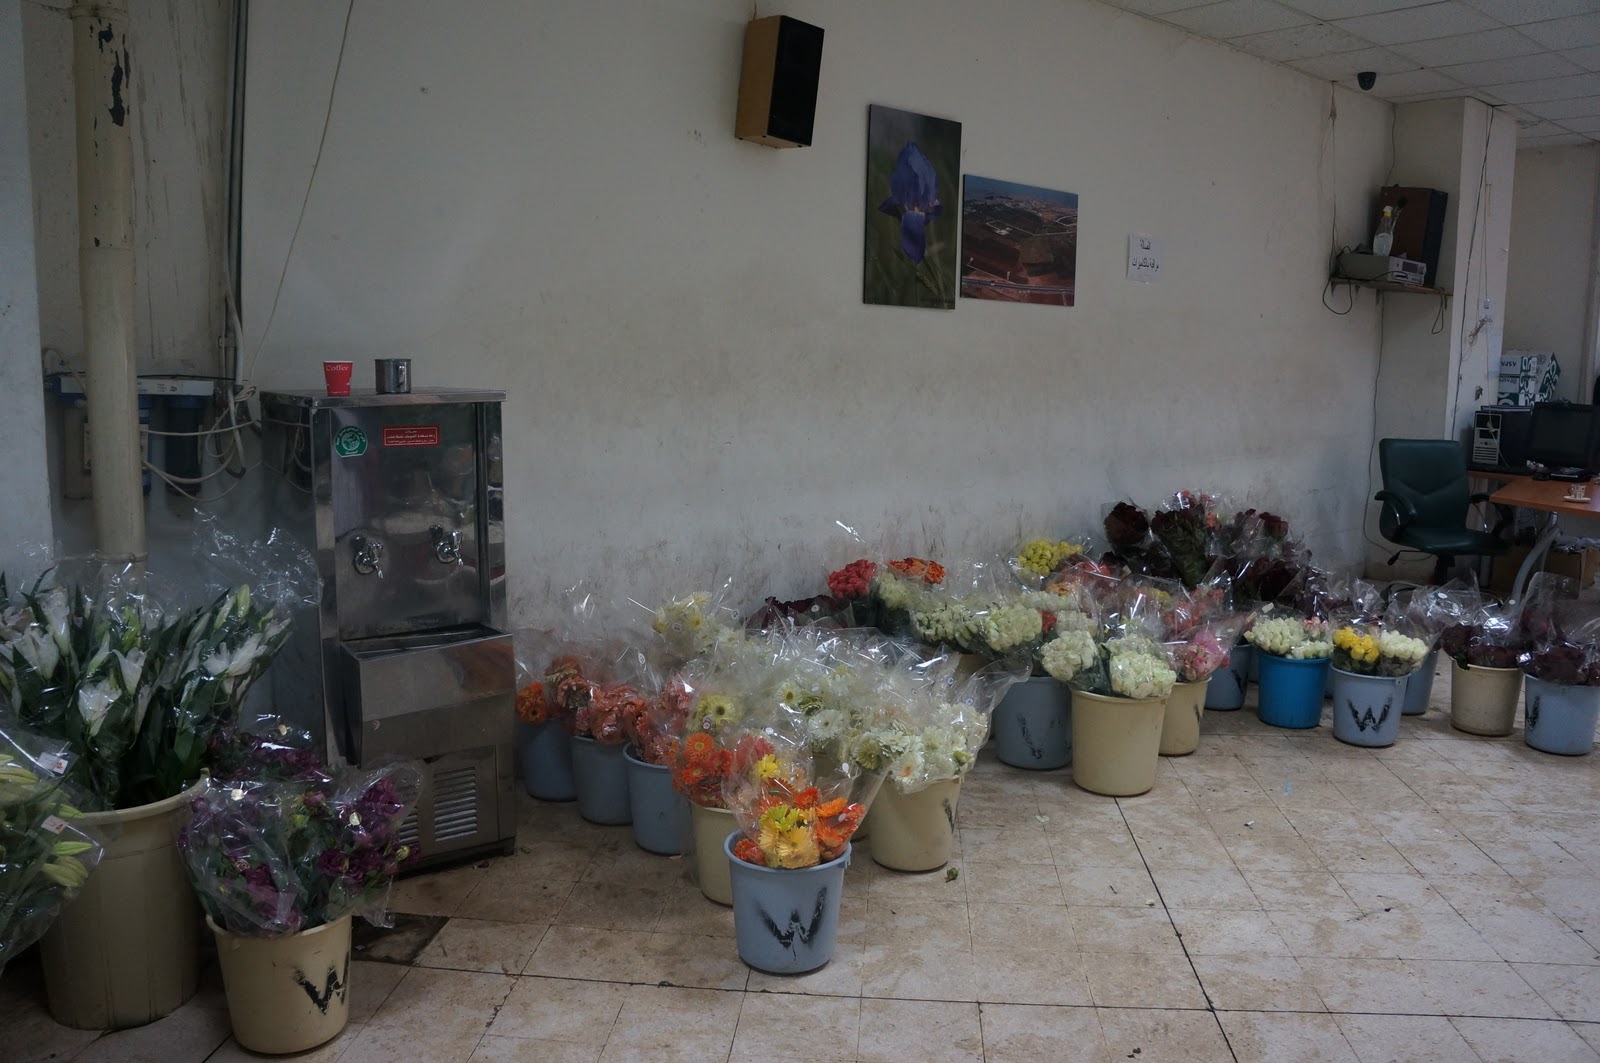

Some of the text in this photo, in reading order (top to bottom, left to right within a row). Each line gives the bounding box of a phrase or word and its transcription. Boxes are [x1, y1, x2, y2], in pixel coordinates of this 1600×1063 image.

[325, 364, 349, 372] Coffee
[1347, 696, 1393, 733] W
[755, 886, 828, 952] W
